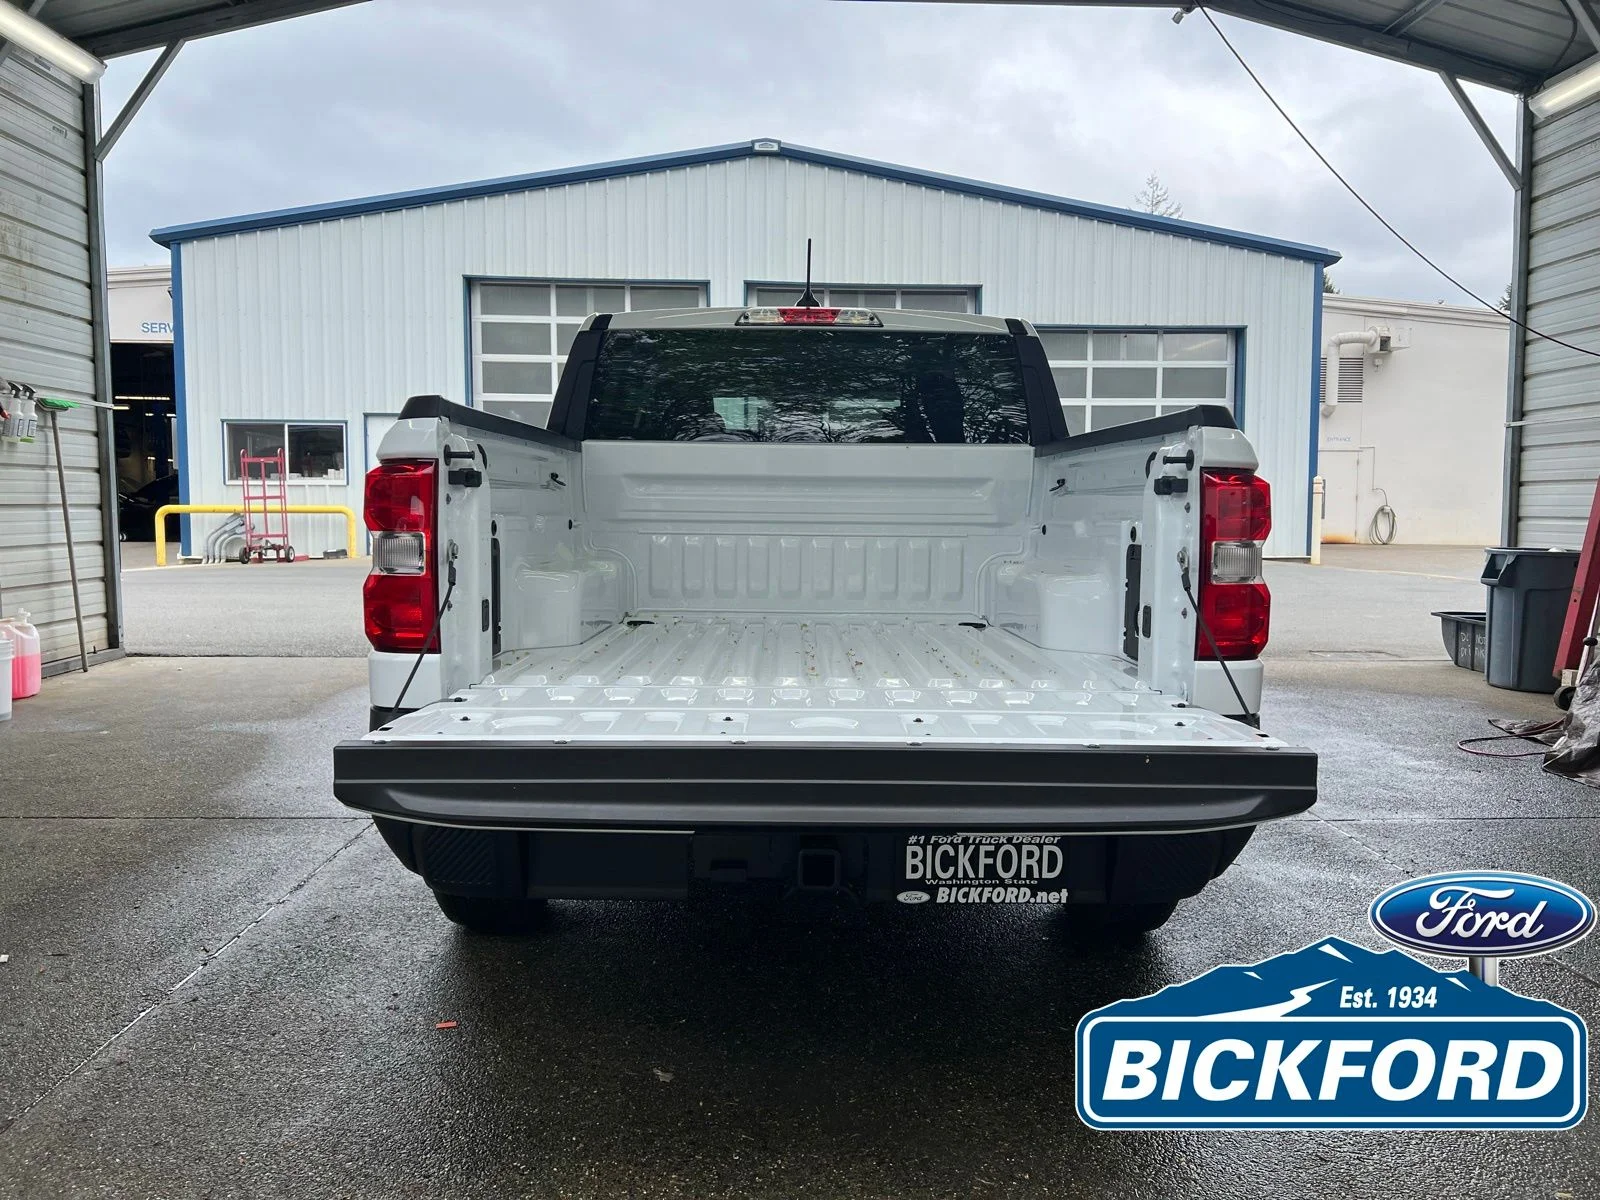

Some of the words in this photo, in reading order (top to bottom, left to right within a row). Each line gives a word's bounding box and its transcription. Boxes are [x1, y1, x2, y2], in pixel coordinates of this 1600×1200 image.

[908, 835, 925, 844] #1
[930, 835, 962, 844] Ford
[968, 836, 1008, 844] Truck
[1012, 836, 1062, 844] Dealer
[905, 844, 1064, 879] BICKFORD
[936, 887, 1068, 904] BICKFORD.net
